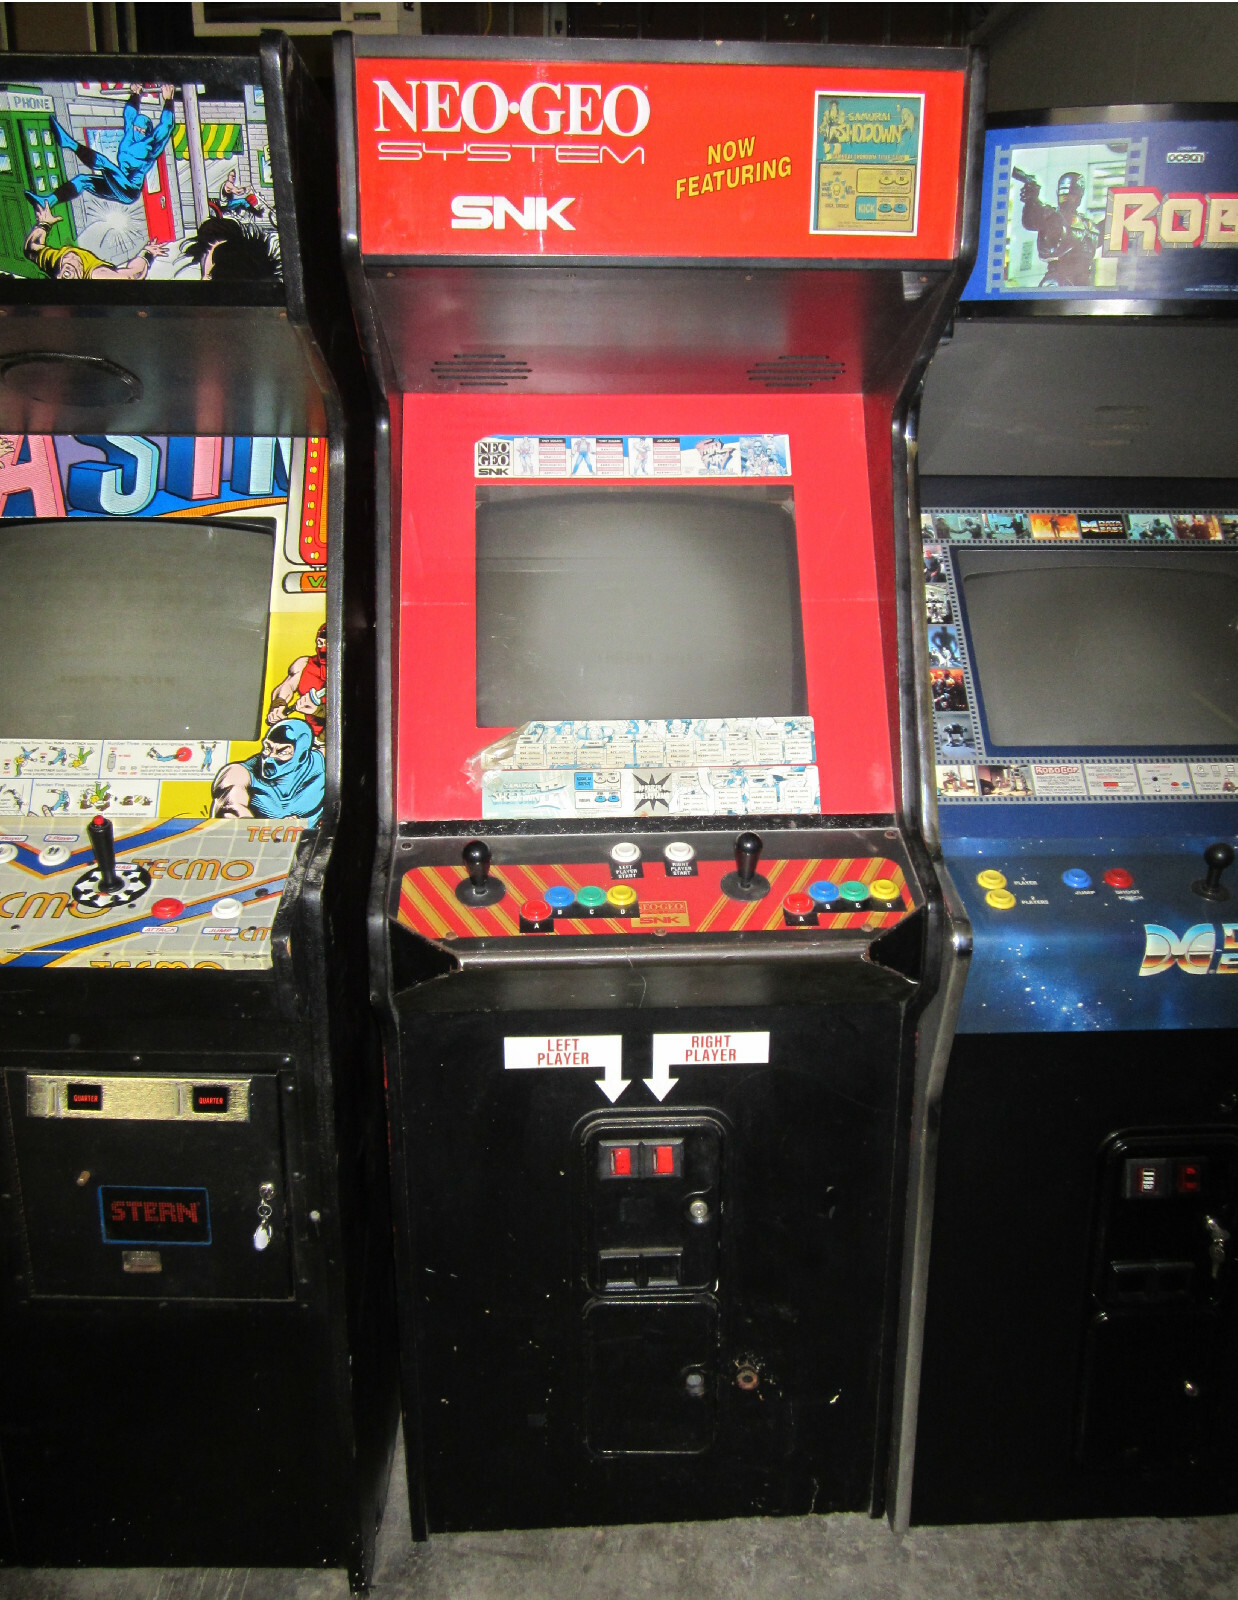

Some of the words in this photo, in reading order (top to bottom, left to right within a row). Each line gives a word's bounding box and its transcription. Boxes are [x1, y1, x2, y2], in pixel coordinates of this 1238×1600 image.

[14, 96, 50, 110] PHONE
[377, 142, 645, 165] SYSTEM
[707, 136, 756, 166] NOW
[675, 156, 792, 199] FEATURING
[451, 196, 576, 231] SNK
[478, 442, 510, 454] NEO
[478, 455, 510, 466] GEO
[478, 468, 509, 476] SNK
[132, 858, 255, 881] TECMO
[640, 916, 680, 924] SNK
[547, 1038, 580, 1052] LEFT
[691, 1035, 732, 1048] RIGHT
[537, 1052, 590, 1066] PLAYER
[685, 1049, 737, 1062] PLAYER
[73, 1094, 99, 1103] QUARTER
[198, 1096, 224, 1105] QUARTER
[111, 1201, 199, 1223] STERN
